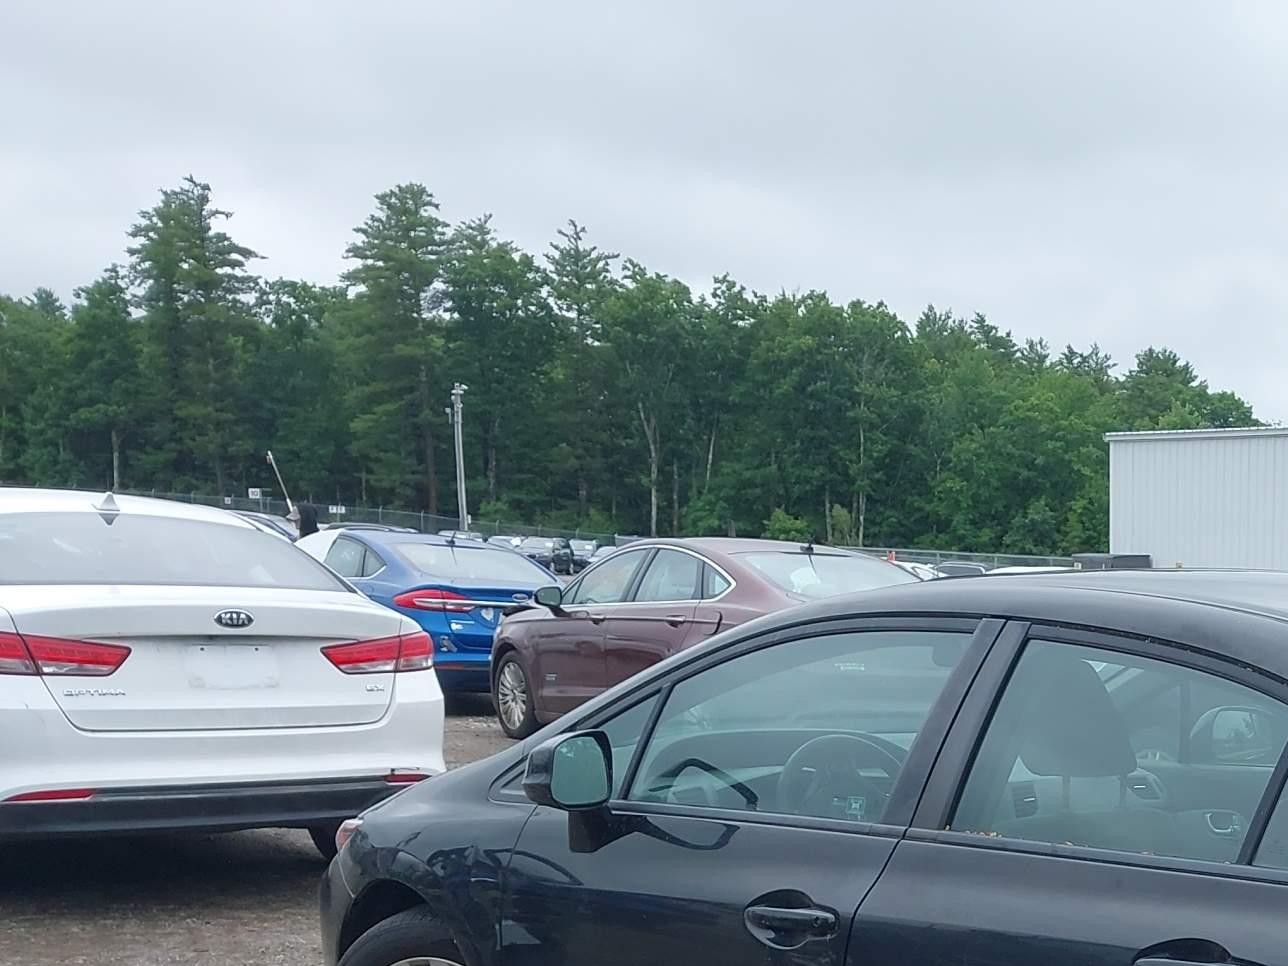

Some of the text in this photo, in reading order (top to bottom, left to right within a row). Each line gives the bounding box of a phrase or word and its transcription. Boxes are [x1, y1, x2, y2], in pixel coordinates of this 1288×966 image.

[221, 612, 249, 625] KIA
[63, 688, 126, 697] OPTIMA
[366, 684, 385, 692] EX
